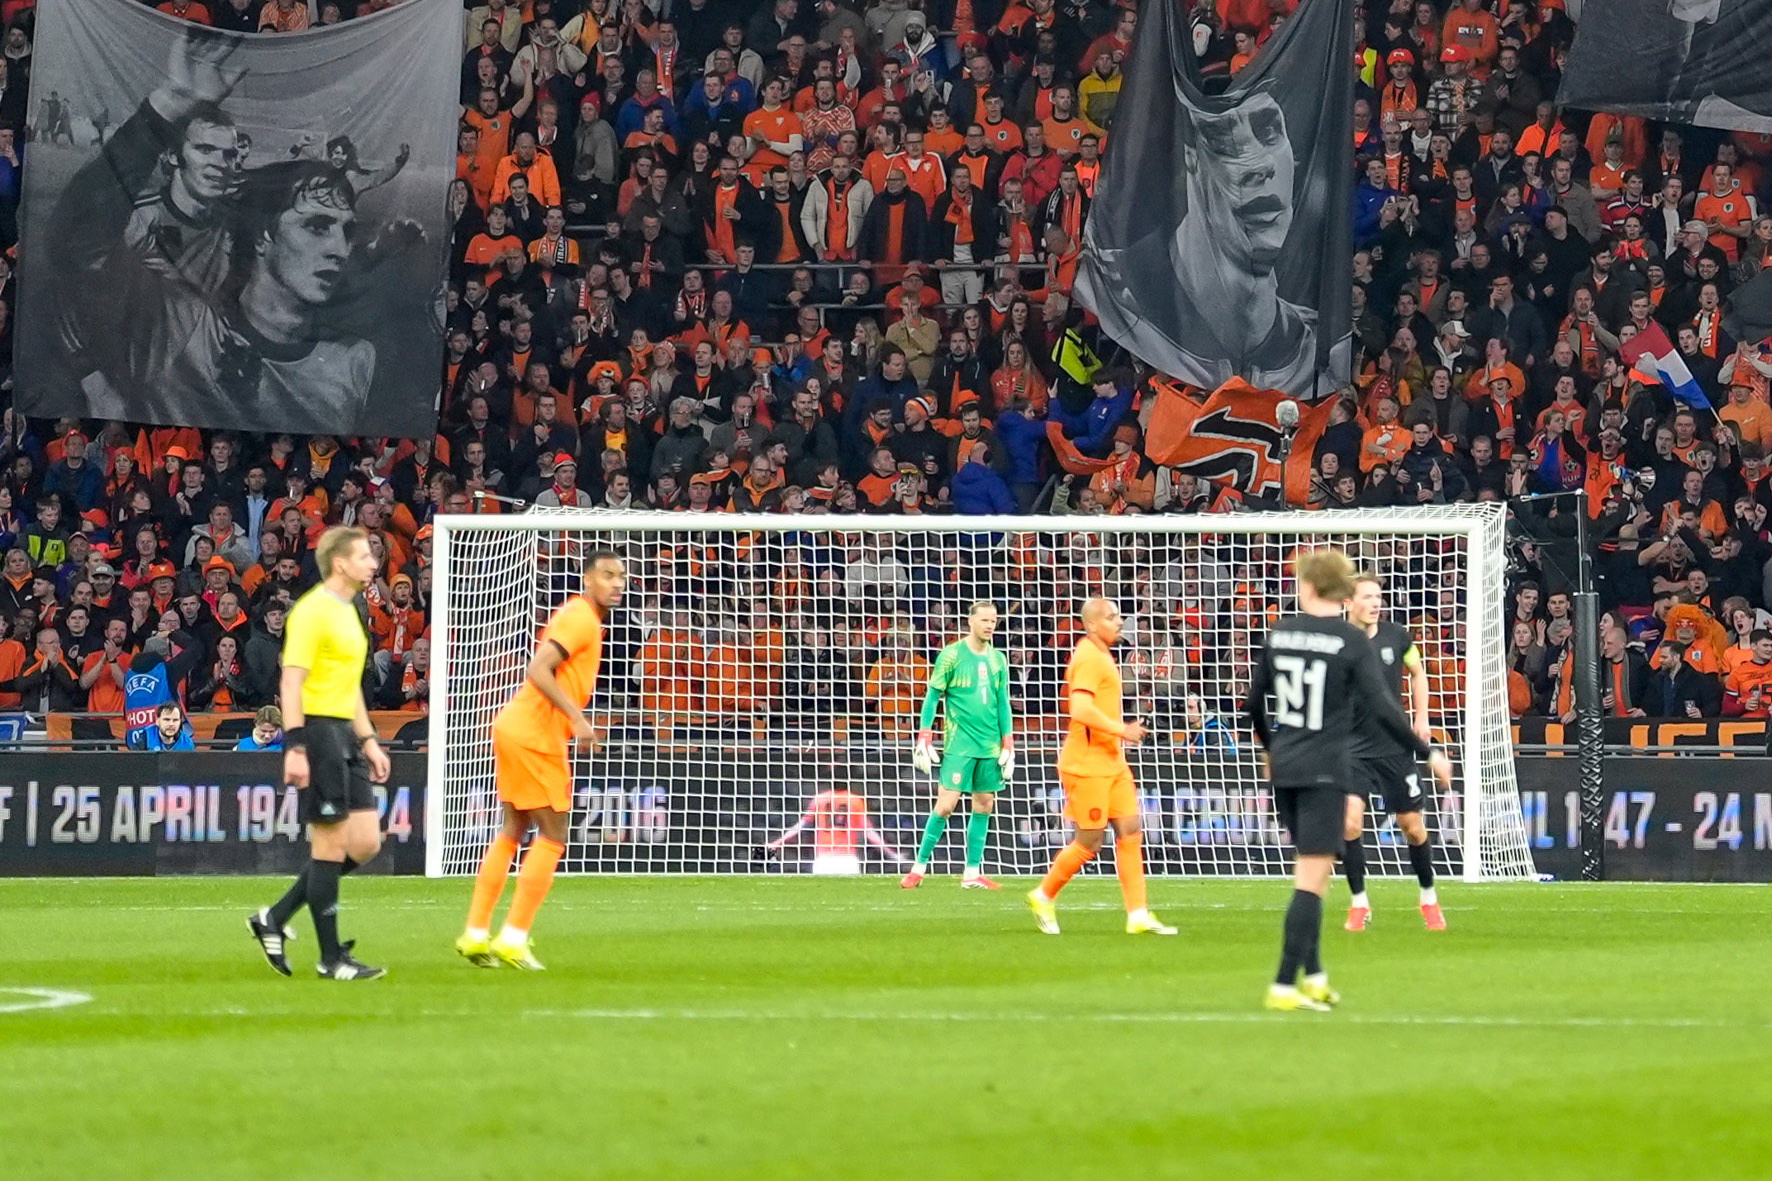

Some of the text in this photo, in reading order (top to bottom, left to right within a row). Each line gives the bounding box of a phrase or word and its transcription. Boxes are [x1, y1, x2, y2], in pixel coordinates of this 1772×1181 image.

[1273, 655, 1327, 730] 21
[51, 785, 101, 842] 25
[110, 784, 226, 842] APRIL
[236, 784, 311, 842] 194
[1564, 791, 1656, 849] 147
[1693, 791, 1743, 850] 24
